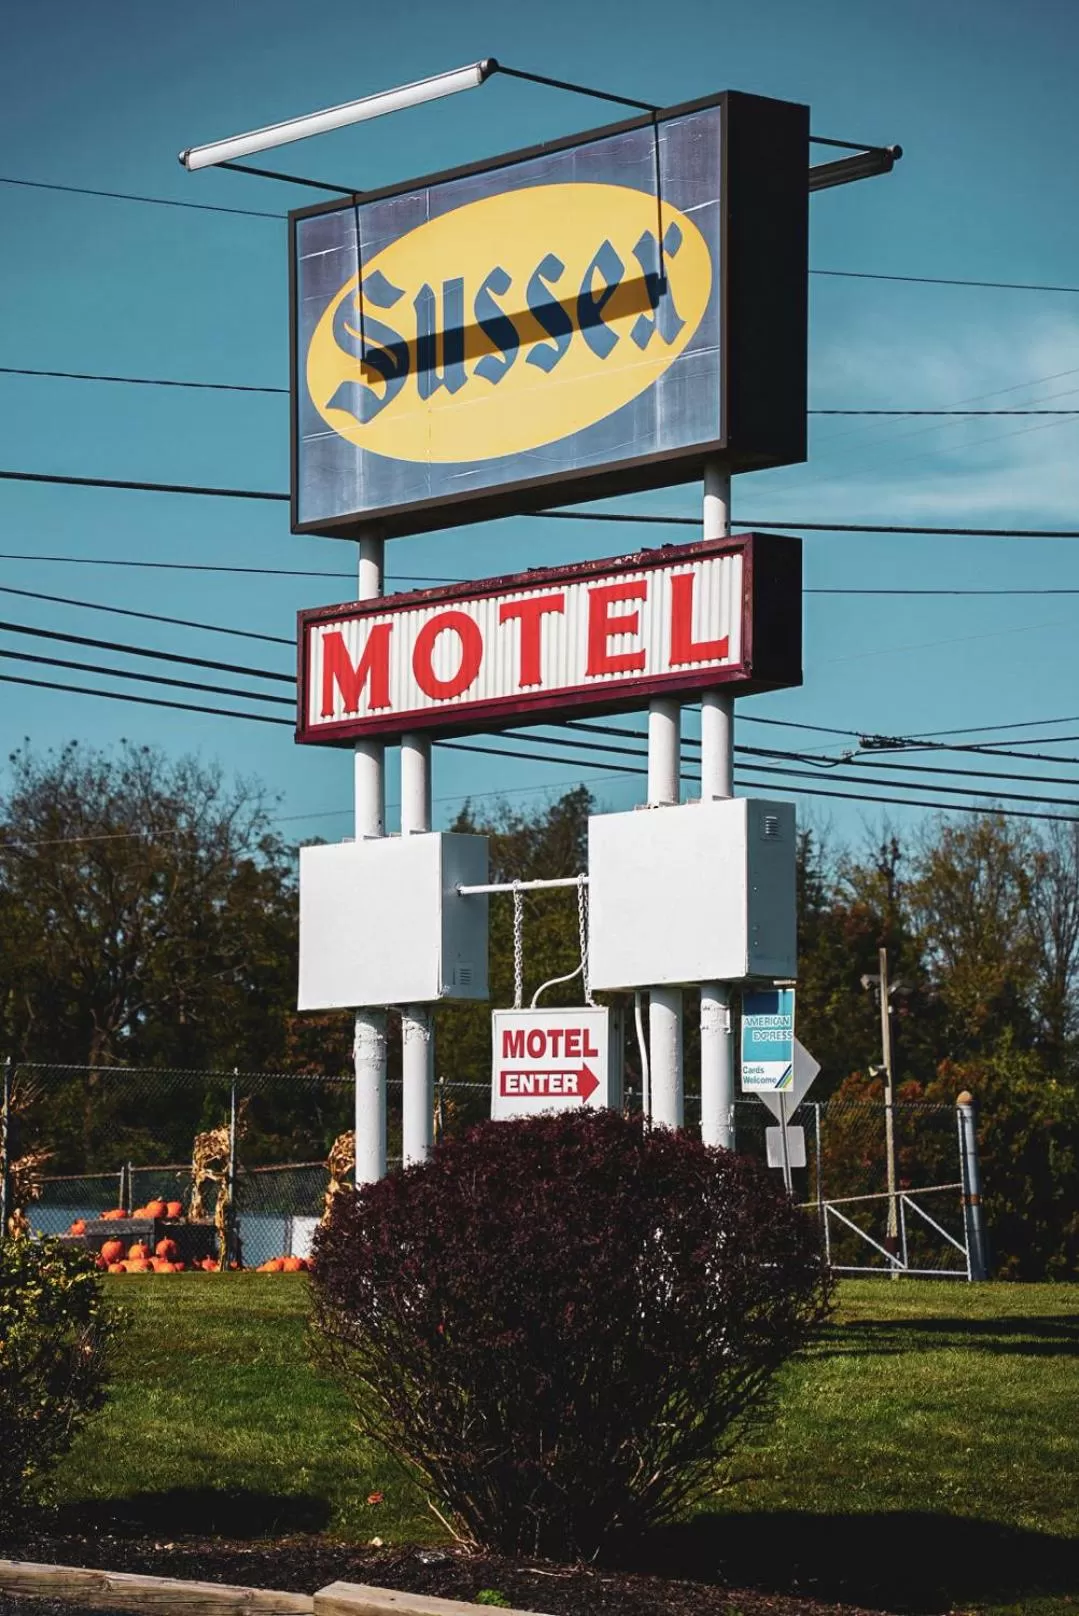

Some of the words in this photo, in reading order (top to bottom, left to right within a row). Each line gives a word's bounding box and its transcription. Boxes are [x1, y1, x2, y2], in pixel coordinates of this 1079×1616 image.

[325, 221, 689, 425] Sussex
[321, 572, 729, 718] MOTEL
[743, 1016, 790, 1027] AMERICAN
[753, 1030, 793, 1041] EXPRESS
[502, 1028, 599, 1059] MOTEL
[742, 1066, 765, 1074] Cards
[505, 1073, 578, 1093] ENTER
[742, 1076, 777, 1084] Welcome
